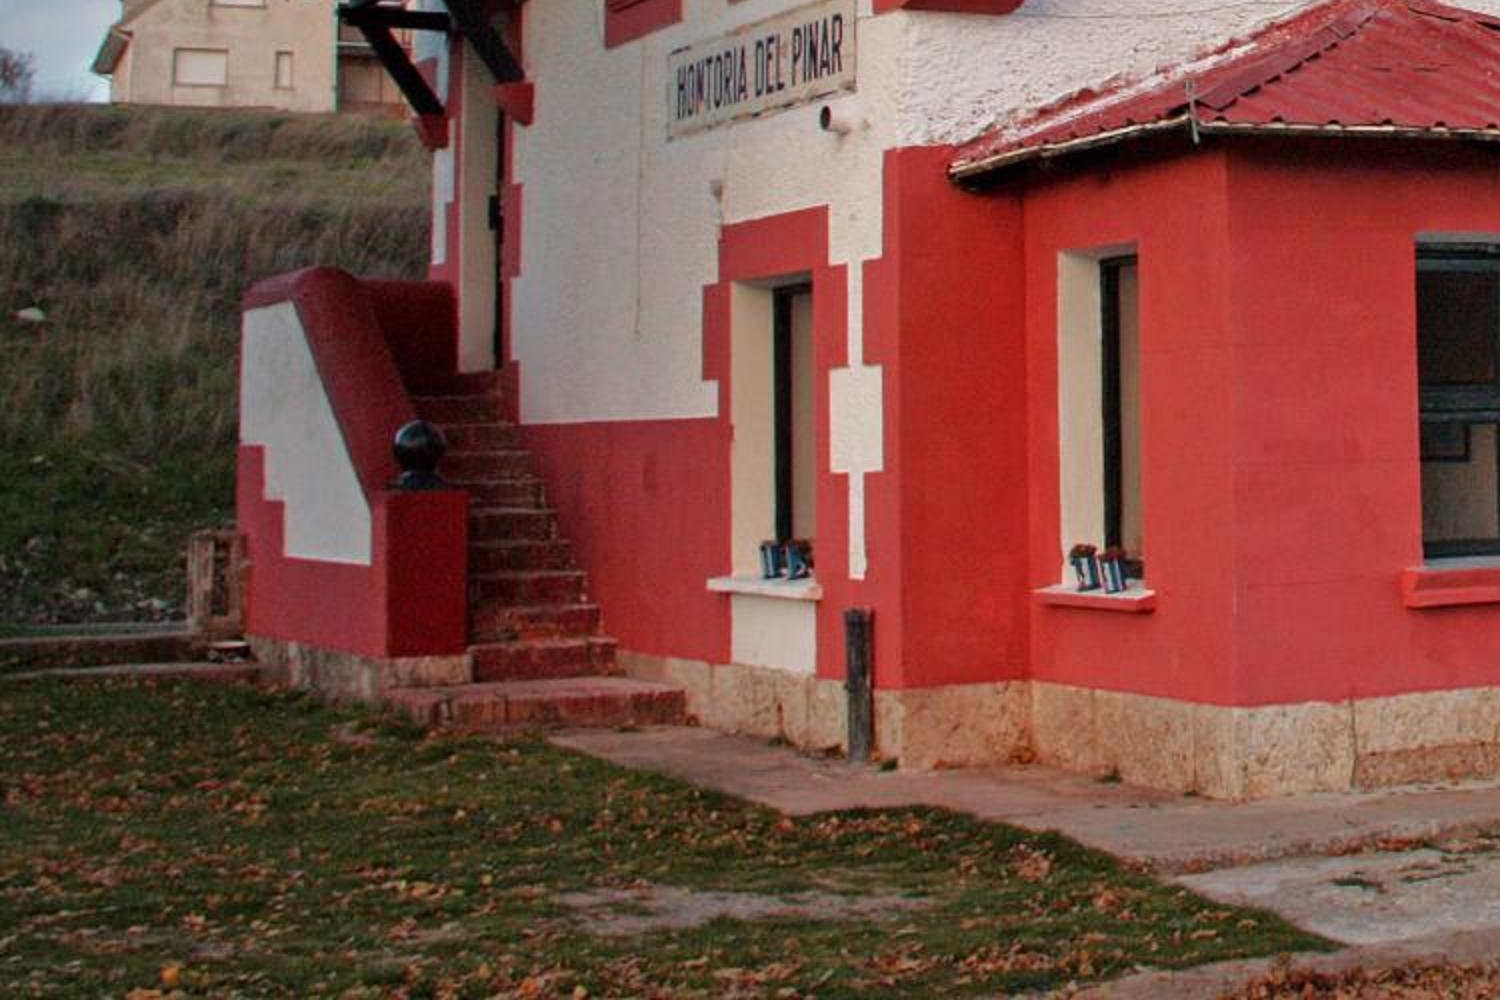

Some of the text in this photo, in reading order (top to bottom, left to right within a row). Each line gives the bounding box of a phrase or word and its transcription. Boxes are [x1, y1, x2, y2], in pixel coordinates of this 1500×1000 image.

[677, 13, 843, 120] HONTORIA DEL PINAR
